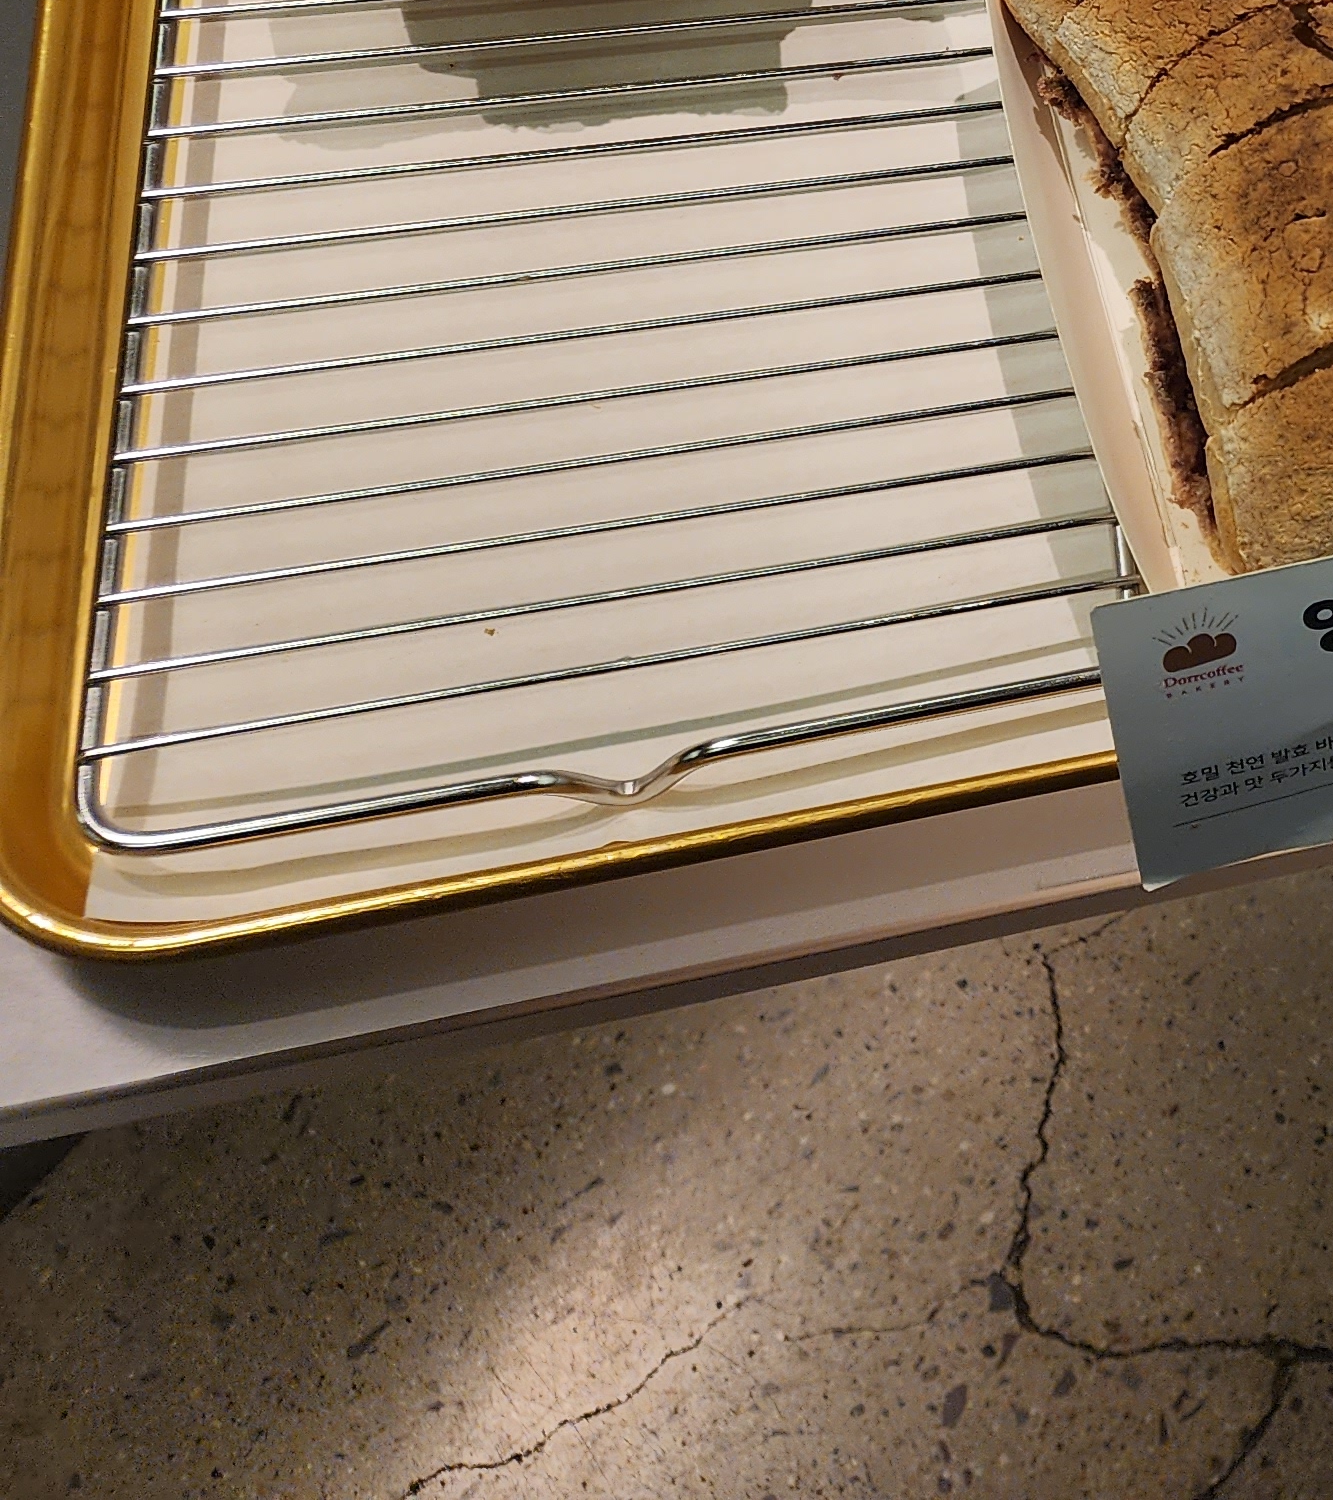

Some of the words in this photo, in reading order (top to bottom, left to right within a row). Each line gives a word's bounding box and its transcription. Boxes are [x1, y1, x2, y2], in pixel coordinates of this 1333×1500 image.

[1163, 664, 1244, 689] Dorrcoffee
[1181, 764, 1220, 785] 호밀
[1226, 753, 1265, 776] 천연
[1271, 743, 1310, 765] 발효
[1180, 781, 1239, 808] 건강과
[1245, 775, 1264, 792] 맛
